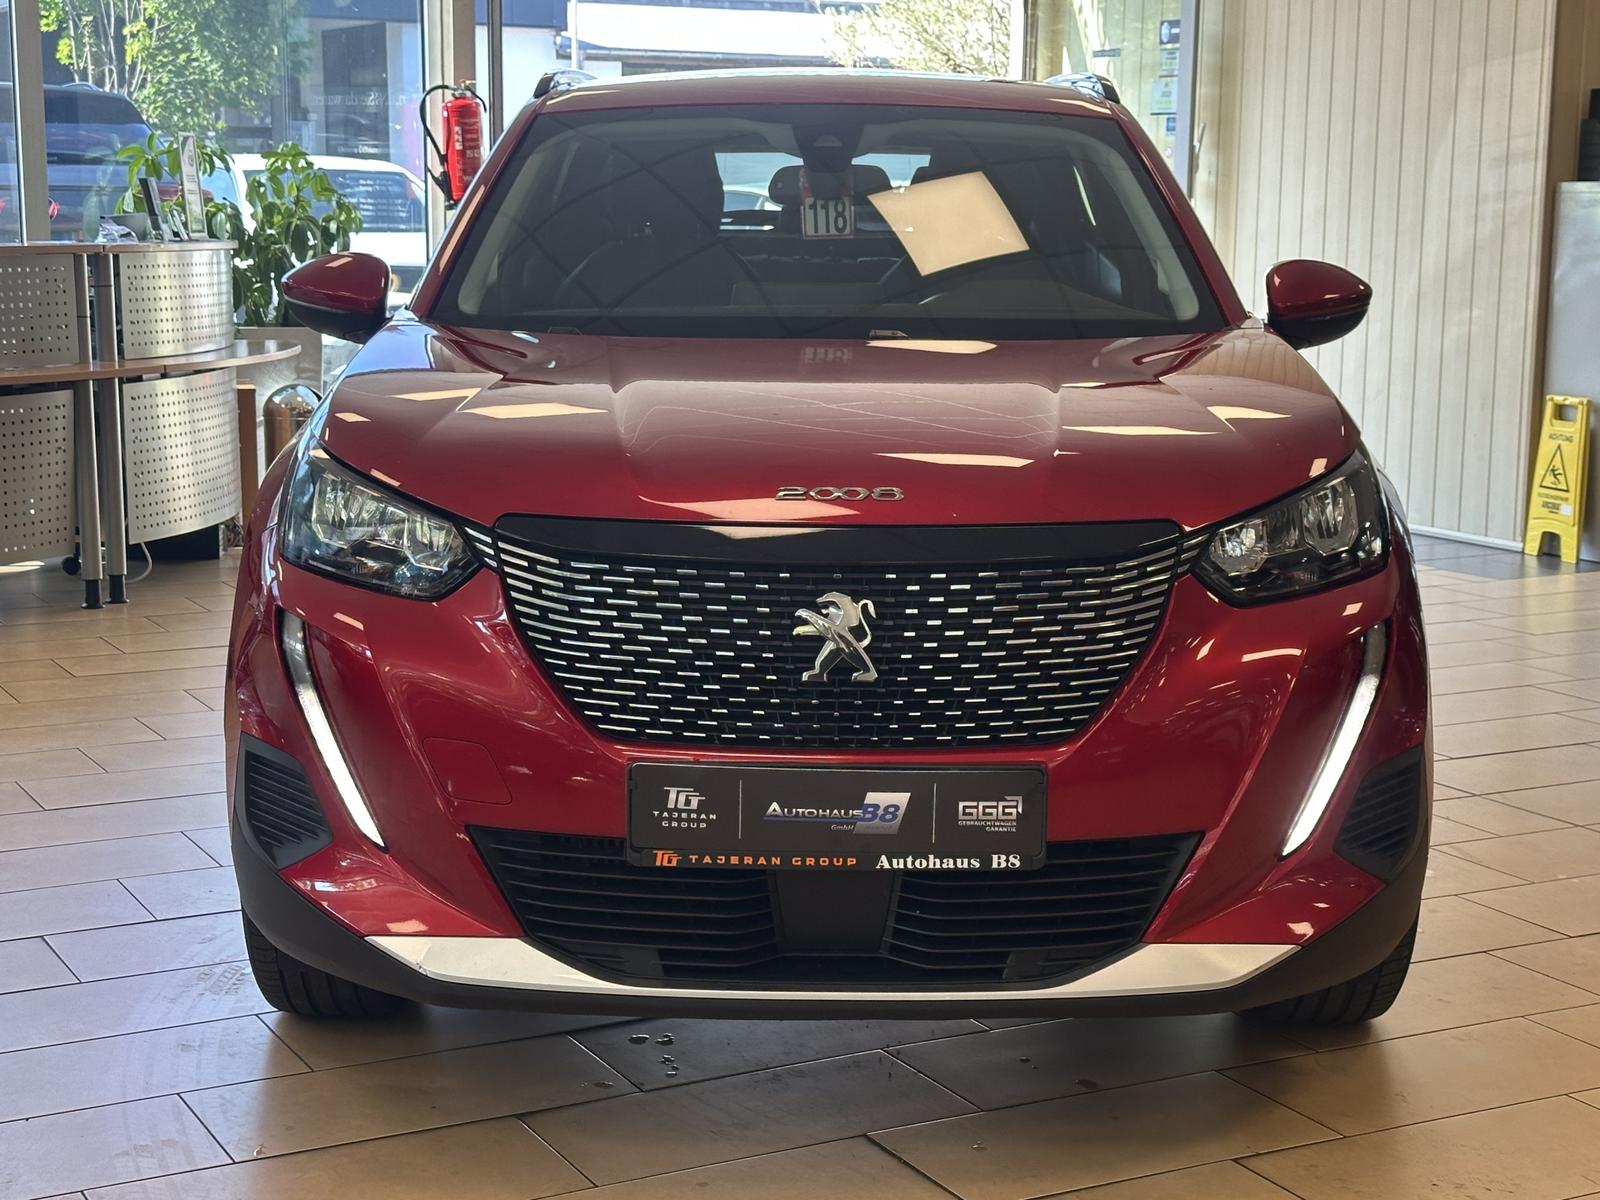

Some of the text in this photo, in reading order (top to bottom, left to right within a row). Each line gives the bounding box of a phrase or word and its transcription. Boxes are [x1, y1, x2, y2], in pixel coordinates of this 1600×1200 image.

[808, 198, 848, 234] 118
[774, 486, 905, 501] 2008
[652, 811, 717, 820] TAJERAN
[861, 803, 901, 823] B8
[958, 801, 1018, 820] GGG
[689, 855, 782, 866] TAJERAN
[791, 856, 858, 867] GROUP
[875, 854, 1021, 870] Autohaus B8
